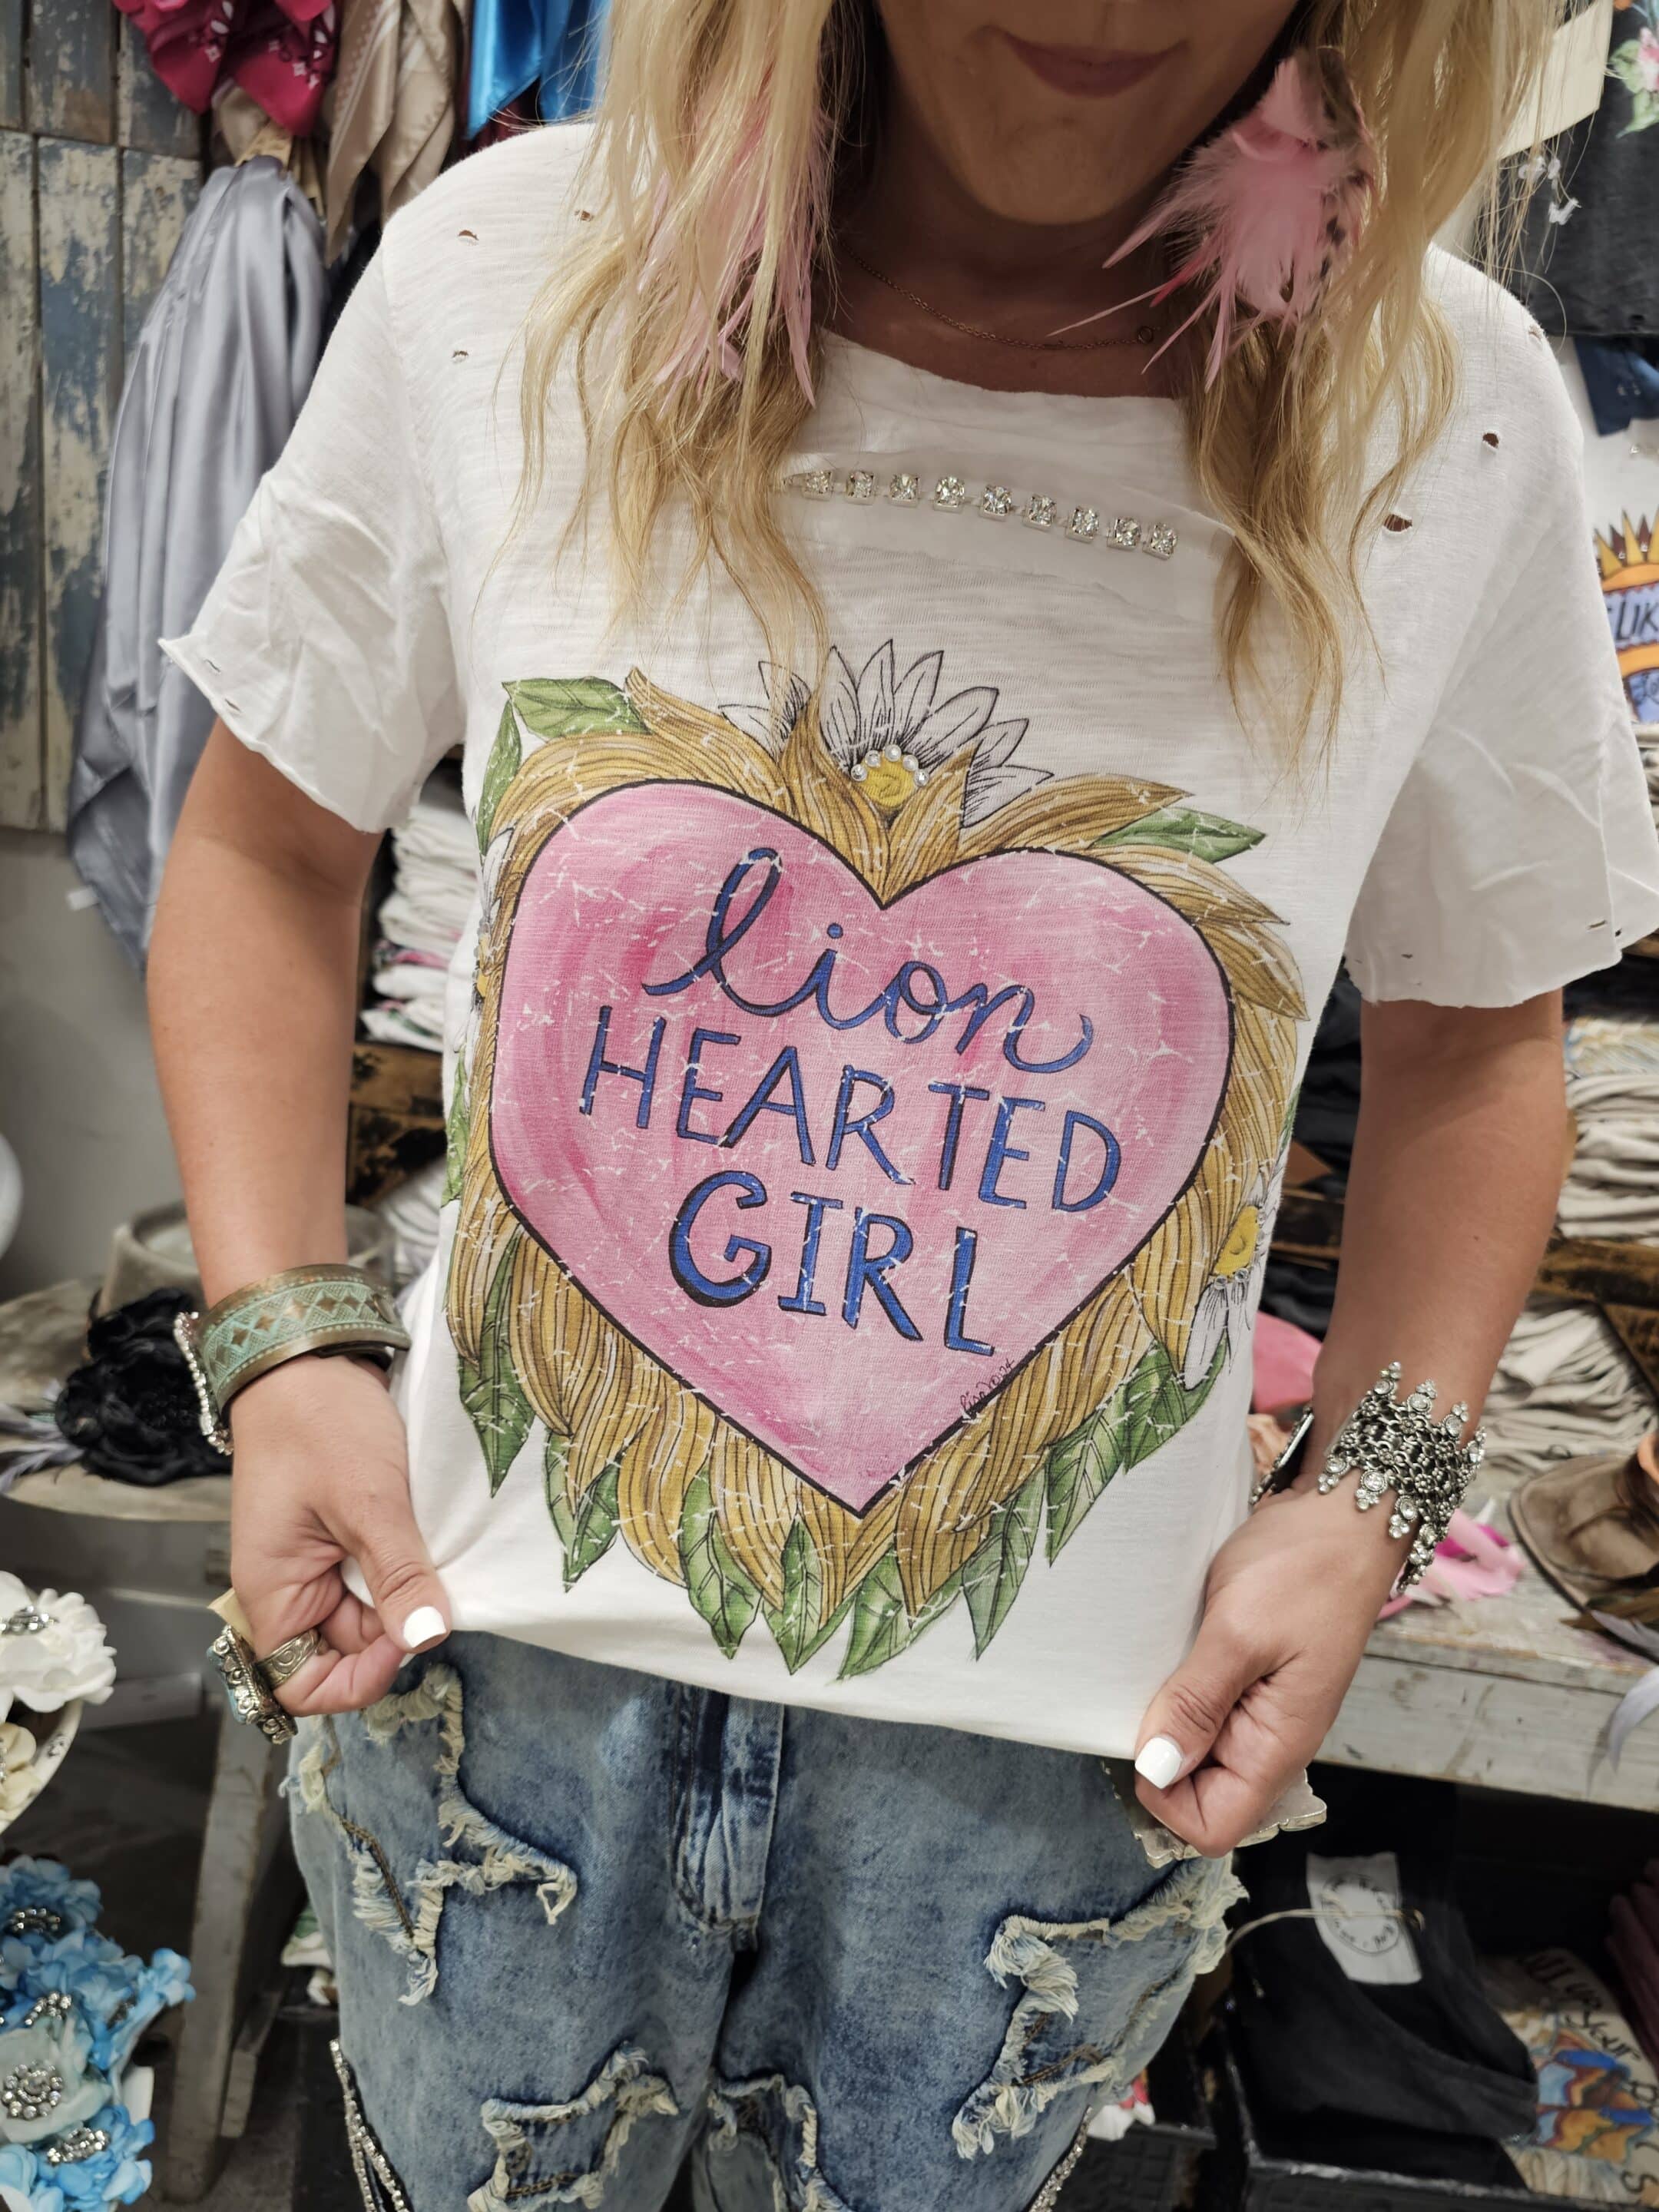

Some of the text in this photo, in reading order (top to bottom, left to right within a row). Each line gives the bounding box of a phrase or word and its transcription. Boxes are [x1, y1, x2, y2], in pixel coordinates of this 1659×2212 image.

[642, 847, 1094, 1073] lion
[579, 1005, 1122, 1213] HEARTED
[669, 1170, 995, 1356] GIRL
